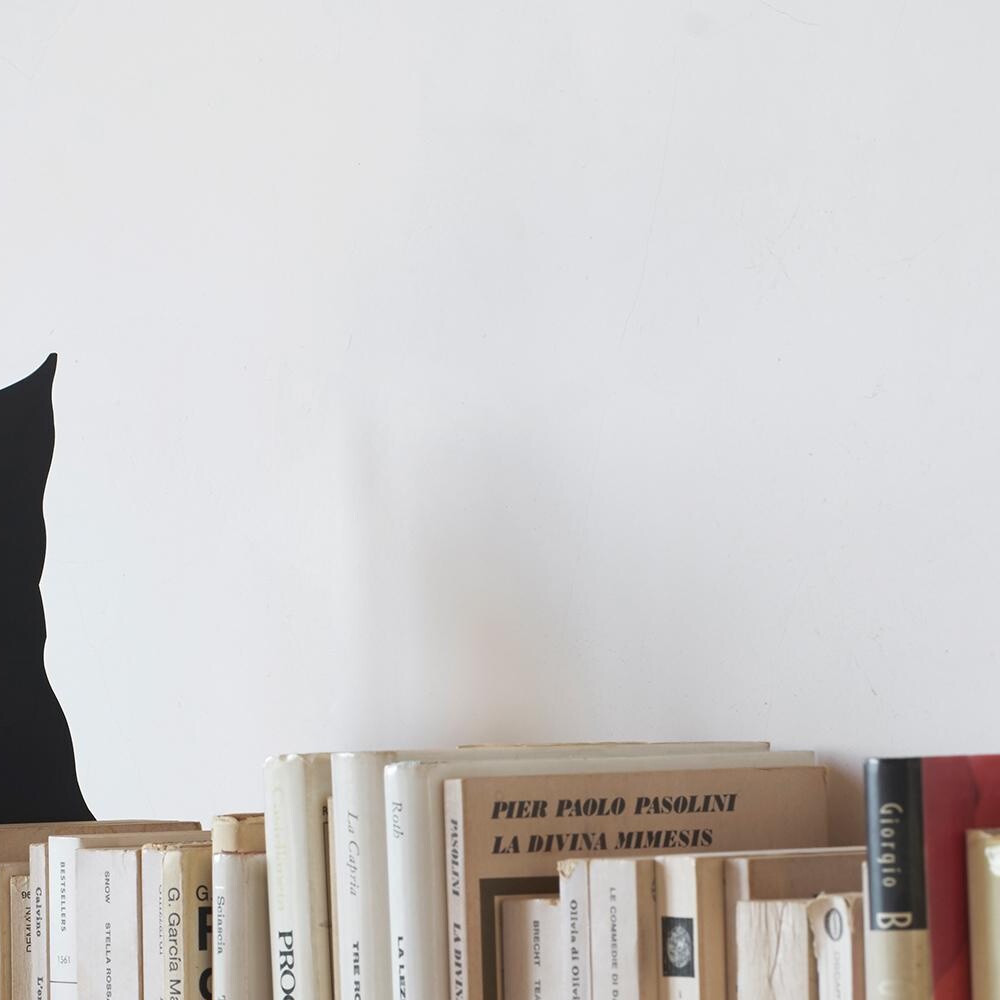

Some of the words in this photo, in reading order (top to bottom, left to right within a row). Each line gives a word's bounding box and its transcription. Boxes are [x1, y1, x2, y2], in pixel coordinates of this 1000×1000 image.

[347, 811, 358, 836] La
[391, 801, 403, 840] Roth
[491, 799, 548, 820] PIER
[555, 797, 626, 818] PAOLO
[633, 793, 737, 815] PASOLINI
[451, 818, 460, 897] PASOLINI
[491, 834, 520, 855] LA
[527, 831, 608, 854] DIVINA
[615, 828, 714, 849] MIMESIS
[878, 802, 904, 888] Giorgio
[346, 841, 360, 897] Capria
[35, 887, 43, 938] Calvino
[168, 887, 180, 908] G.
[610, 887, 617, 903] LE
[216, 896, 226, 955] Sciascia
[453, 923, 461, 946] LA
[570, 899, 579, 944] Olivia
[610, 906, 618, 970] COMMEDIE
[168, 912, 181, 972] García
[397, 936, 405, 959] LA
[533, 920, 541, 967] BRECHT
[571, 947, 579, 962] di
[611, 973, 618, 986] DI
